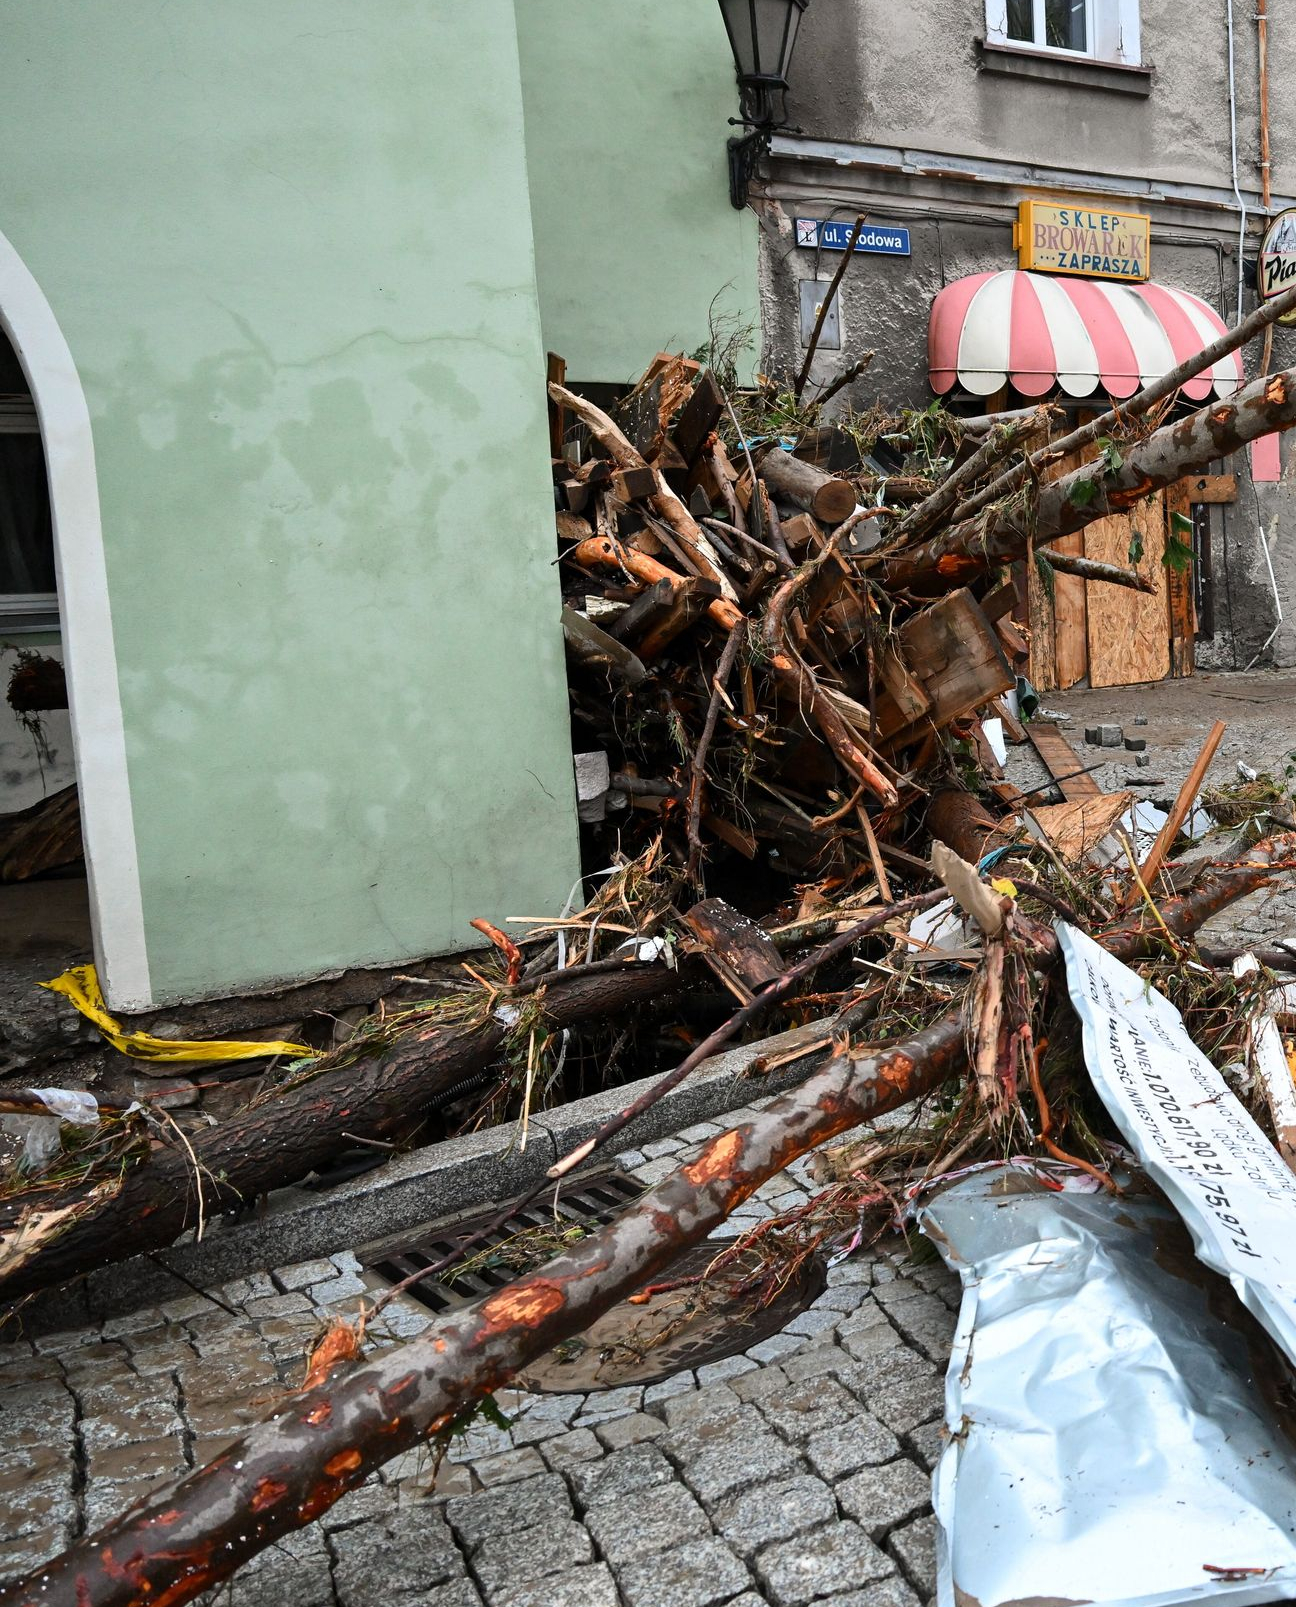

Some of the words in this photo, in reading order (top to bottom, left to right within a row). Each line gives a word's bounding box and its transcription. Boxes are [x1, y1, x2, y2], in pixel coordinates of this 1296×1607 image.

[1059, 210, 1120, 231] SKLEP
[824, 228, 841, 243] ul.
[845, 229, 902, 248] Sodowa
[1201, 1161, 1232, 1175] zł
[1230, 1237, 1262, 1257] zł
